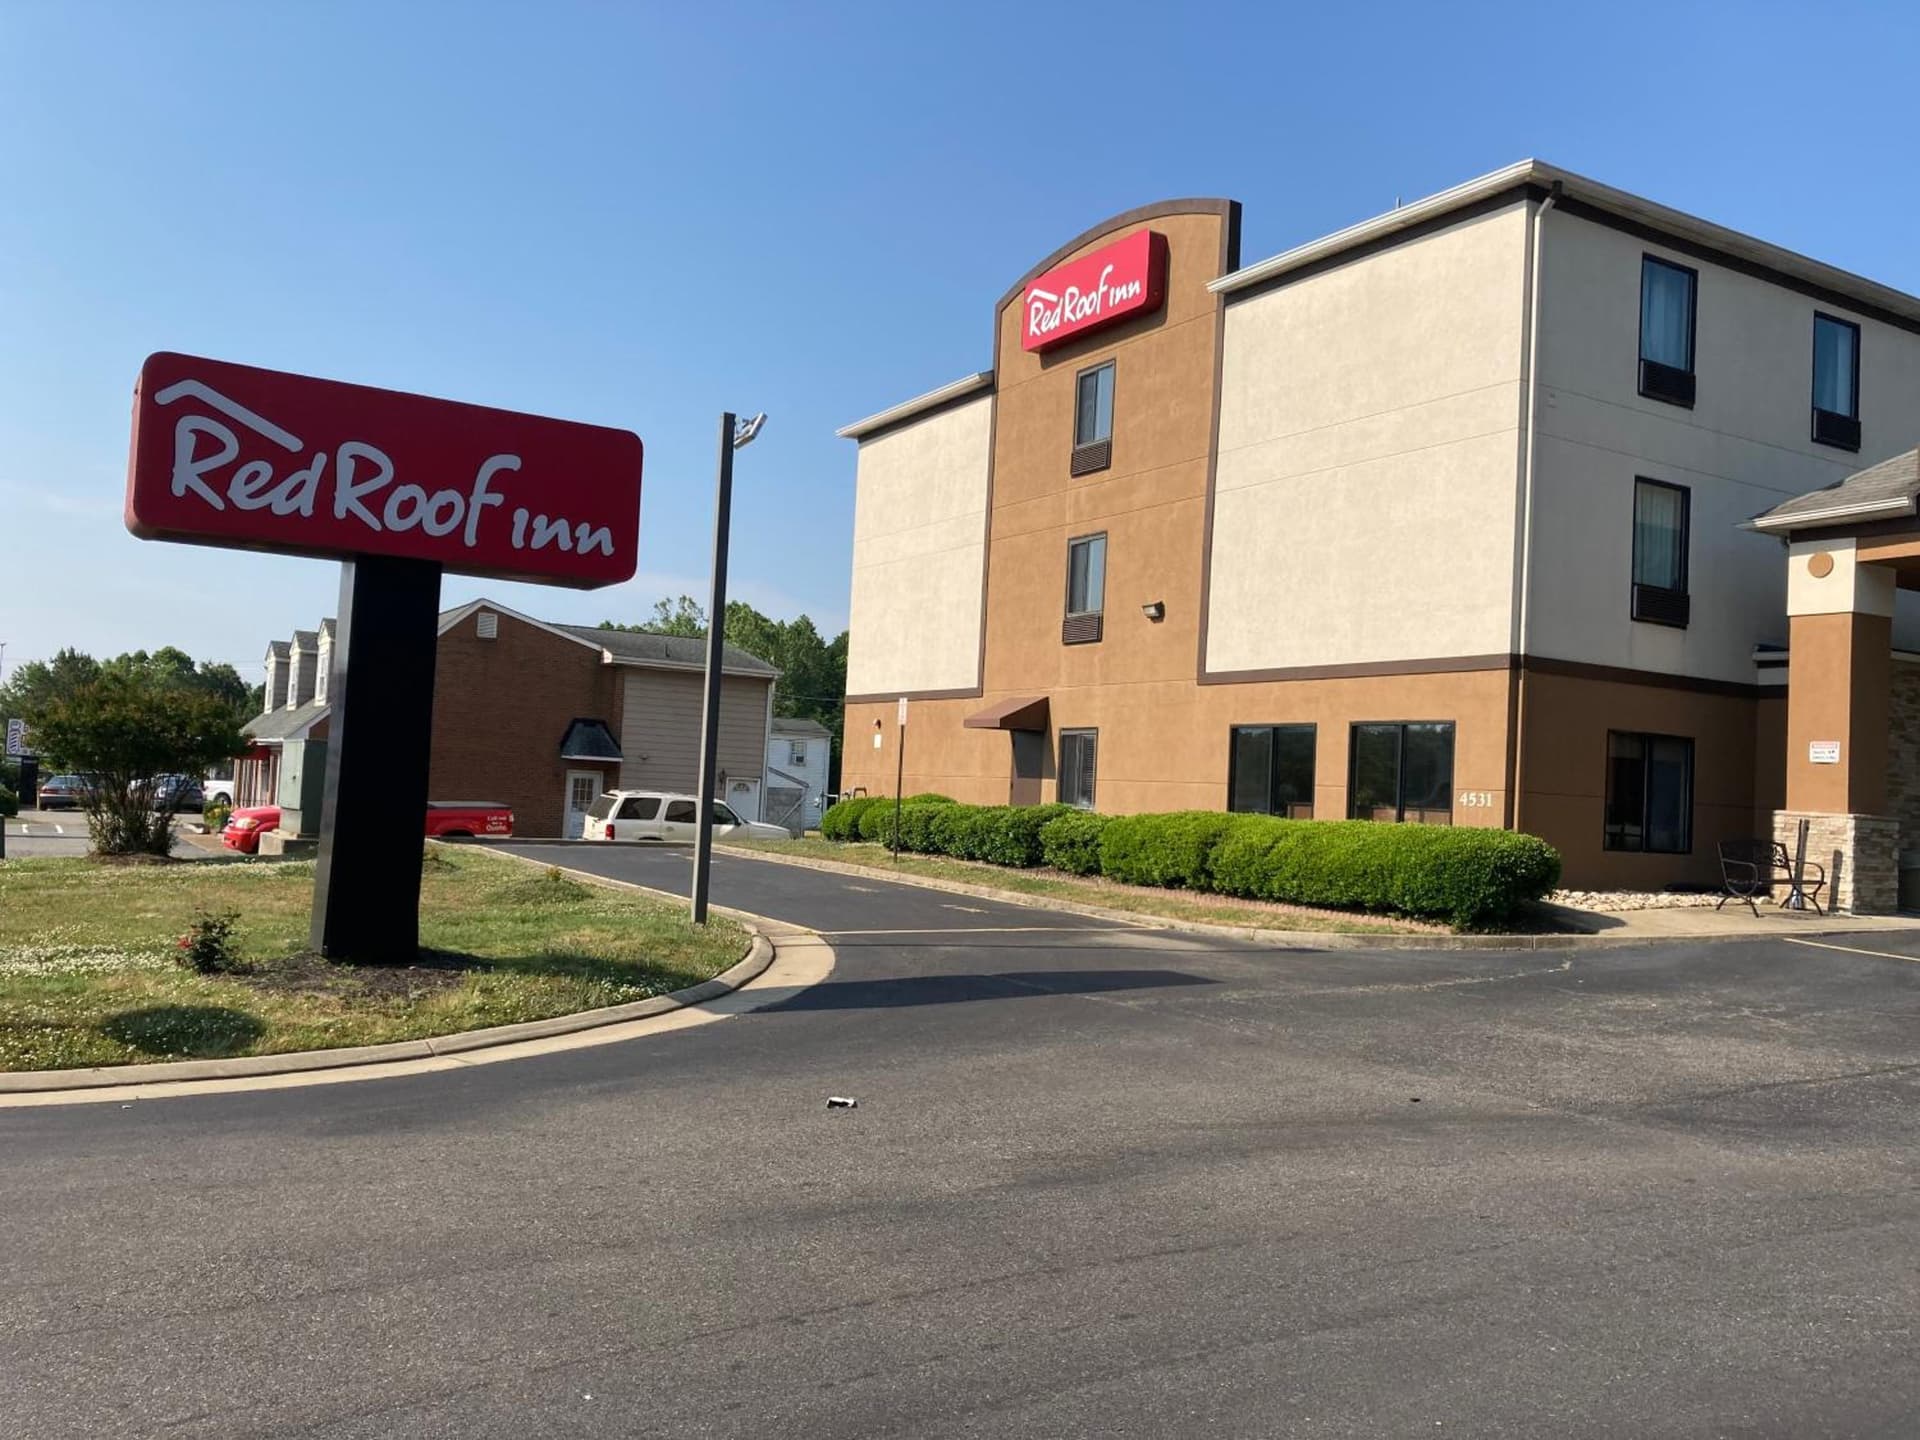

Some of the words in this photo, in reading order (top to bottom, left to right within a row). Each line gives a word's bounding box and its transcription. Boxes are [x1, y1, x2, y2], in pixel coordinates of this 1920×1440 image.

[1029, 298, 1063, 336] Red
[1064, 264, 1113, 322] Roof
[172, 416, 327, 516] Red
[334, 442, 521, 546] Roof
[1459, 792, 1492, 807] 4531
